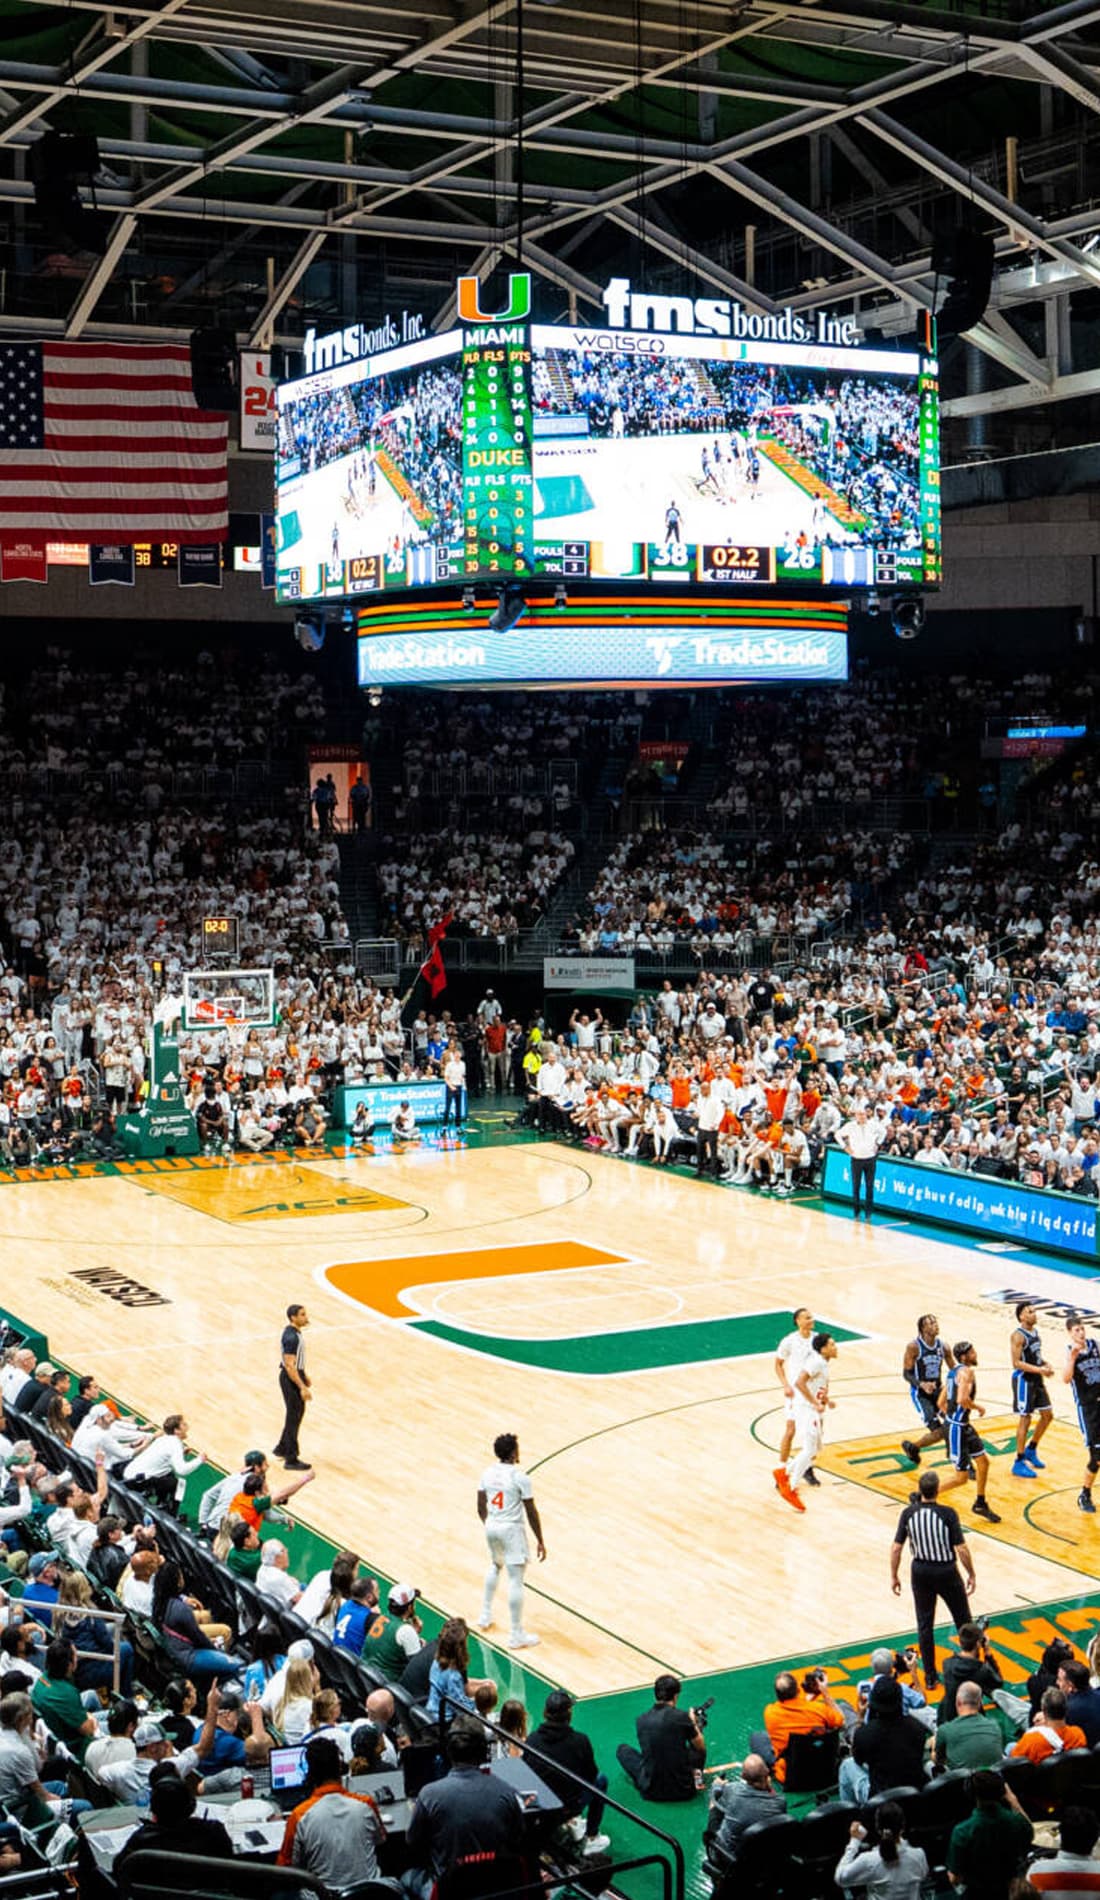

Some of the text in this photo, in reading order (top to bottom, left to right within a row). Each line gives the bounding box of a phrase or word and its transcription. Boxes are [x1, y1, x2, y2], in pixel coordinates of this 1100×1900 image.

[403, 310, 426, 342] Inc.
[818, 312, 859, 346] Inc.
[465, 327, 524, 347] MIAMI
[483, 350, 504, 361] FLS
[510, 351, 531, 362] PTS
[488, 365, 497, 377] 0
[488, 382, 497, 393] 0
[513, 381, 523, 393] 0
[490, 399, 497, 410] 1
[511, 398, 526, 410] 14
[490, 415, 497, 426] 1
[488, 432, 498, 444] 0
[514, 431, 523, 443] 0
[469, 449, 524, 467] DUKE
[488, 490, 498, 502] 0
[488, 507, 498, 519] 0
[515, 507, 524, 519] 0
[490, 525, 497, 536] 1
[488, 542, 499, 554] 0
[534, 547, 562, 556] FOULS
[135, 552, 152, 566] 38
[712, 547, 759, 567] 02.2
[784, 544, 816, 569] 26
[353, 558, 376, 577] 02.2
[489, 559, 499, 570] 2
[690, 638, 828, 665] TradeStation
[67, 1266, 173, 1307] WATSCO
[491, 1490, 504, 1510] 4
[336, 1614, 352, 1639] 4
